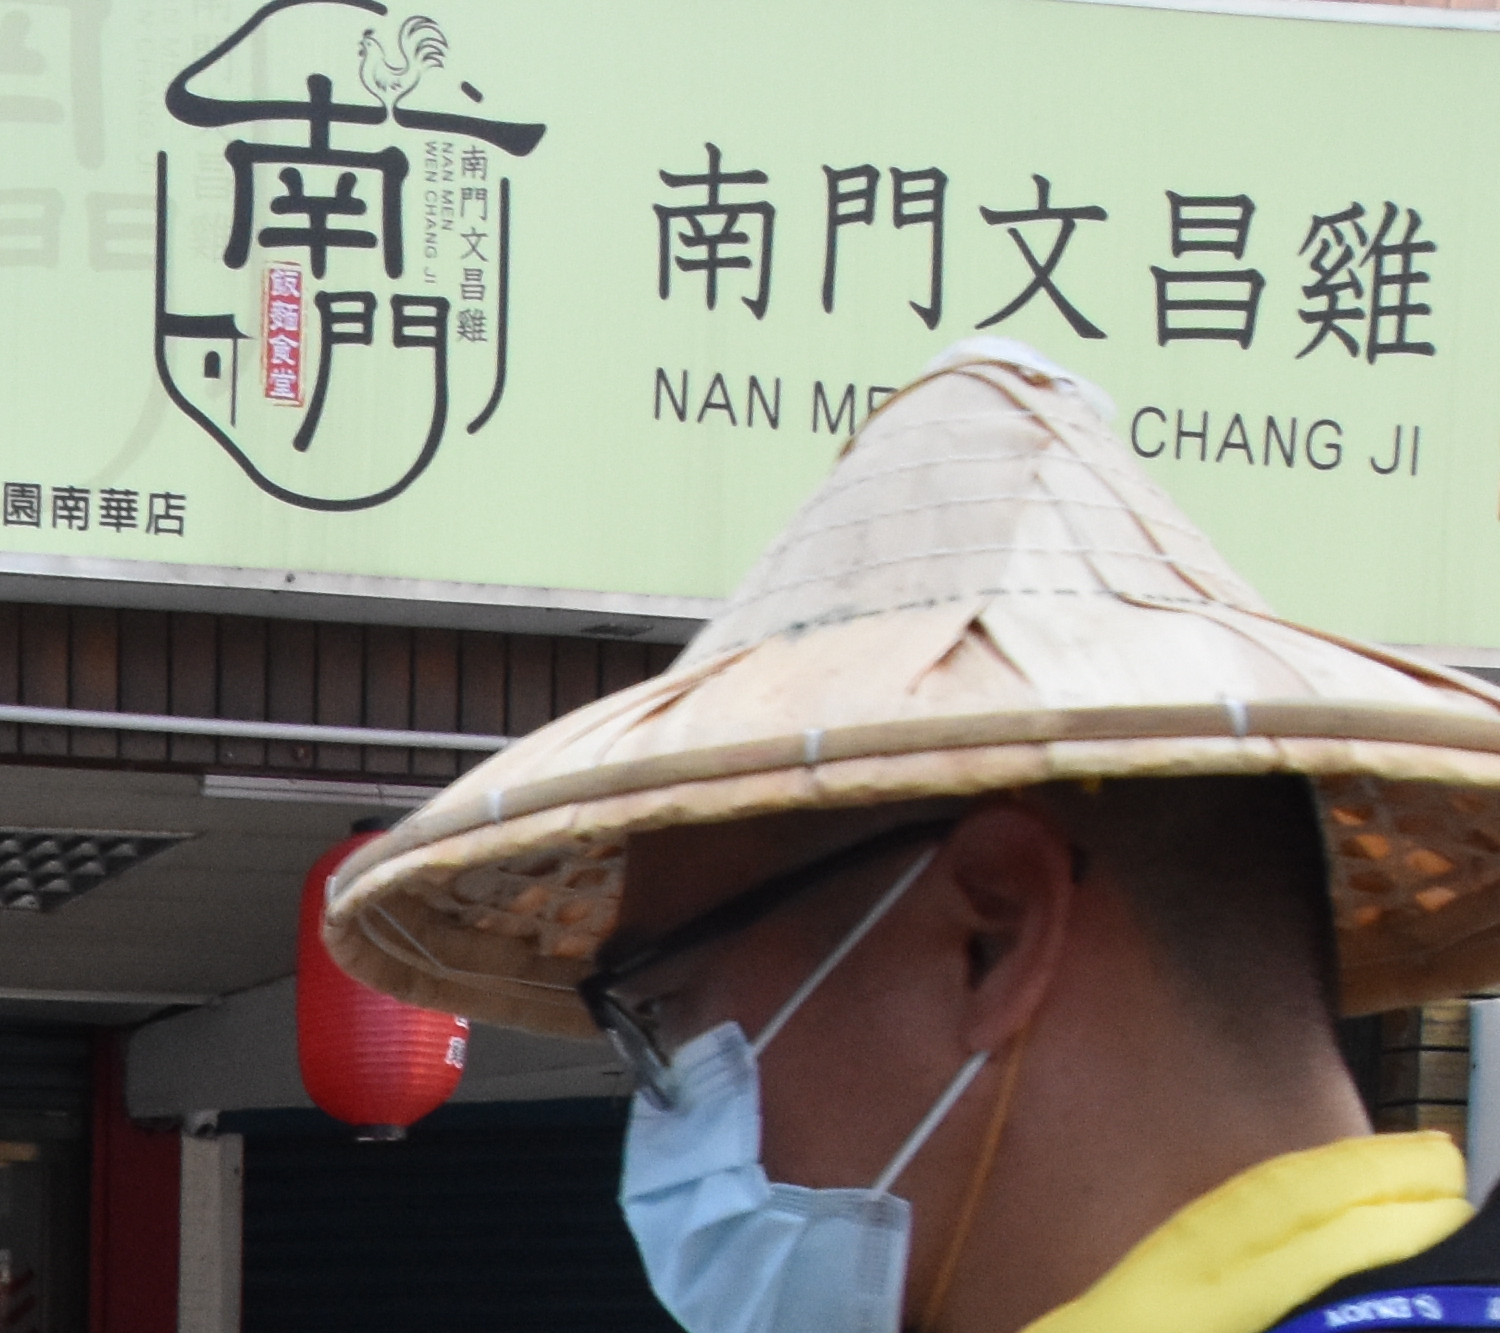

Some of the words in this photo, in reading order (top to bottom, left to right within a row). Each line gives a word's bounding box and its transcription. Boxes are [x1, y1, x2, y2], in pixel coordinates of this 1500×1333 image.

[424, 141, 438, 183] WEN
[441, 142, 454, 179] NAN
[424, 188, 438, 259] CHANG
[441, 187, 454, 232] MEN
[456, 145, 489, 344] 南門文昌雞
[652, 142, 1438, 365] 南門文昌雞
[424, 266, 437, 284] JI
[654, 366, 782, 431] NAN
[1130, 405, 1344, 471] CHANG
[1370, 423, 1423, 477] JI
